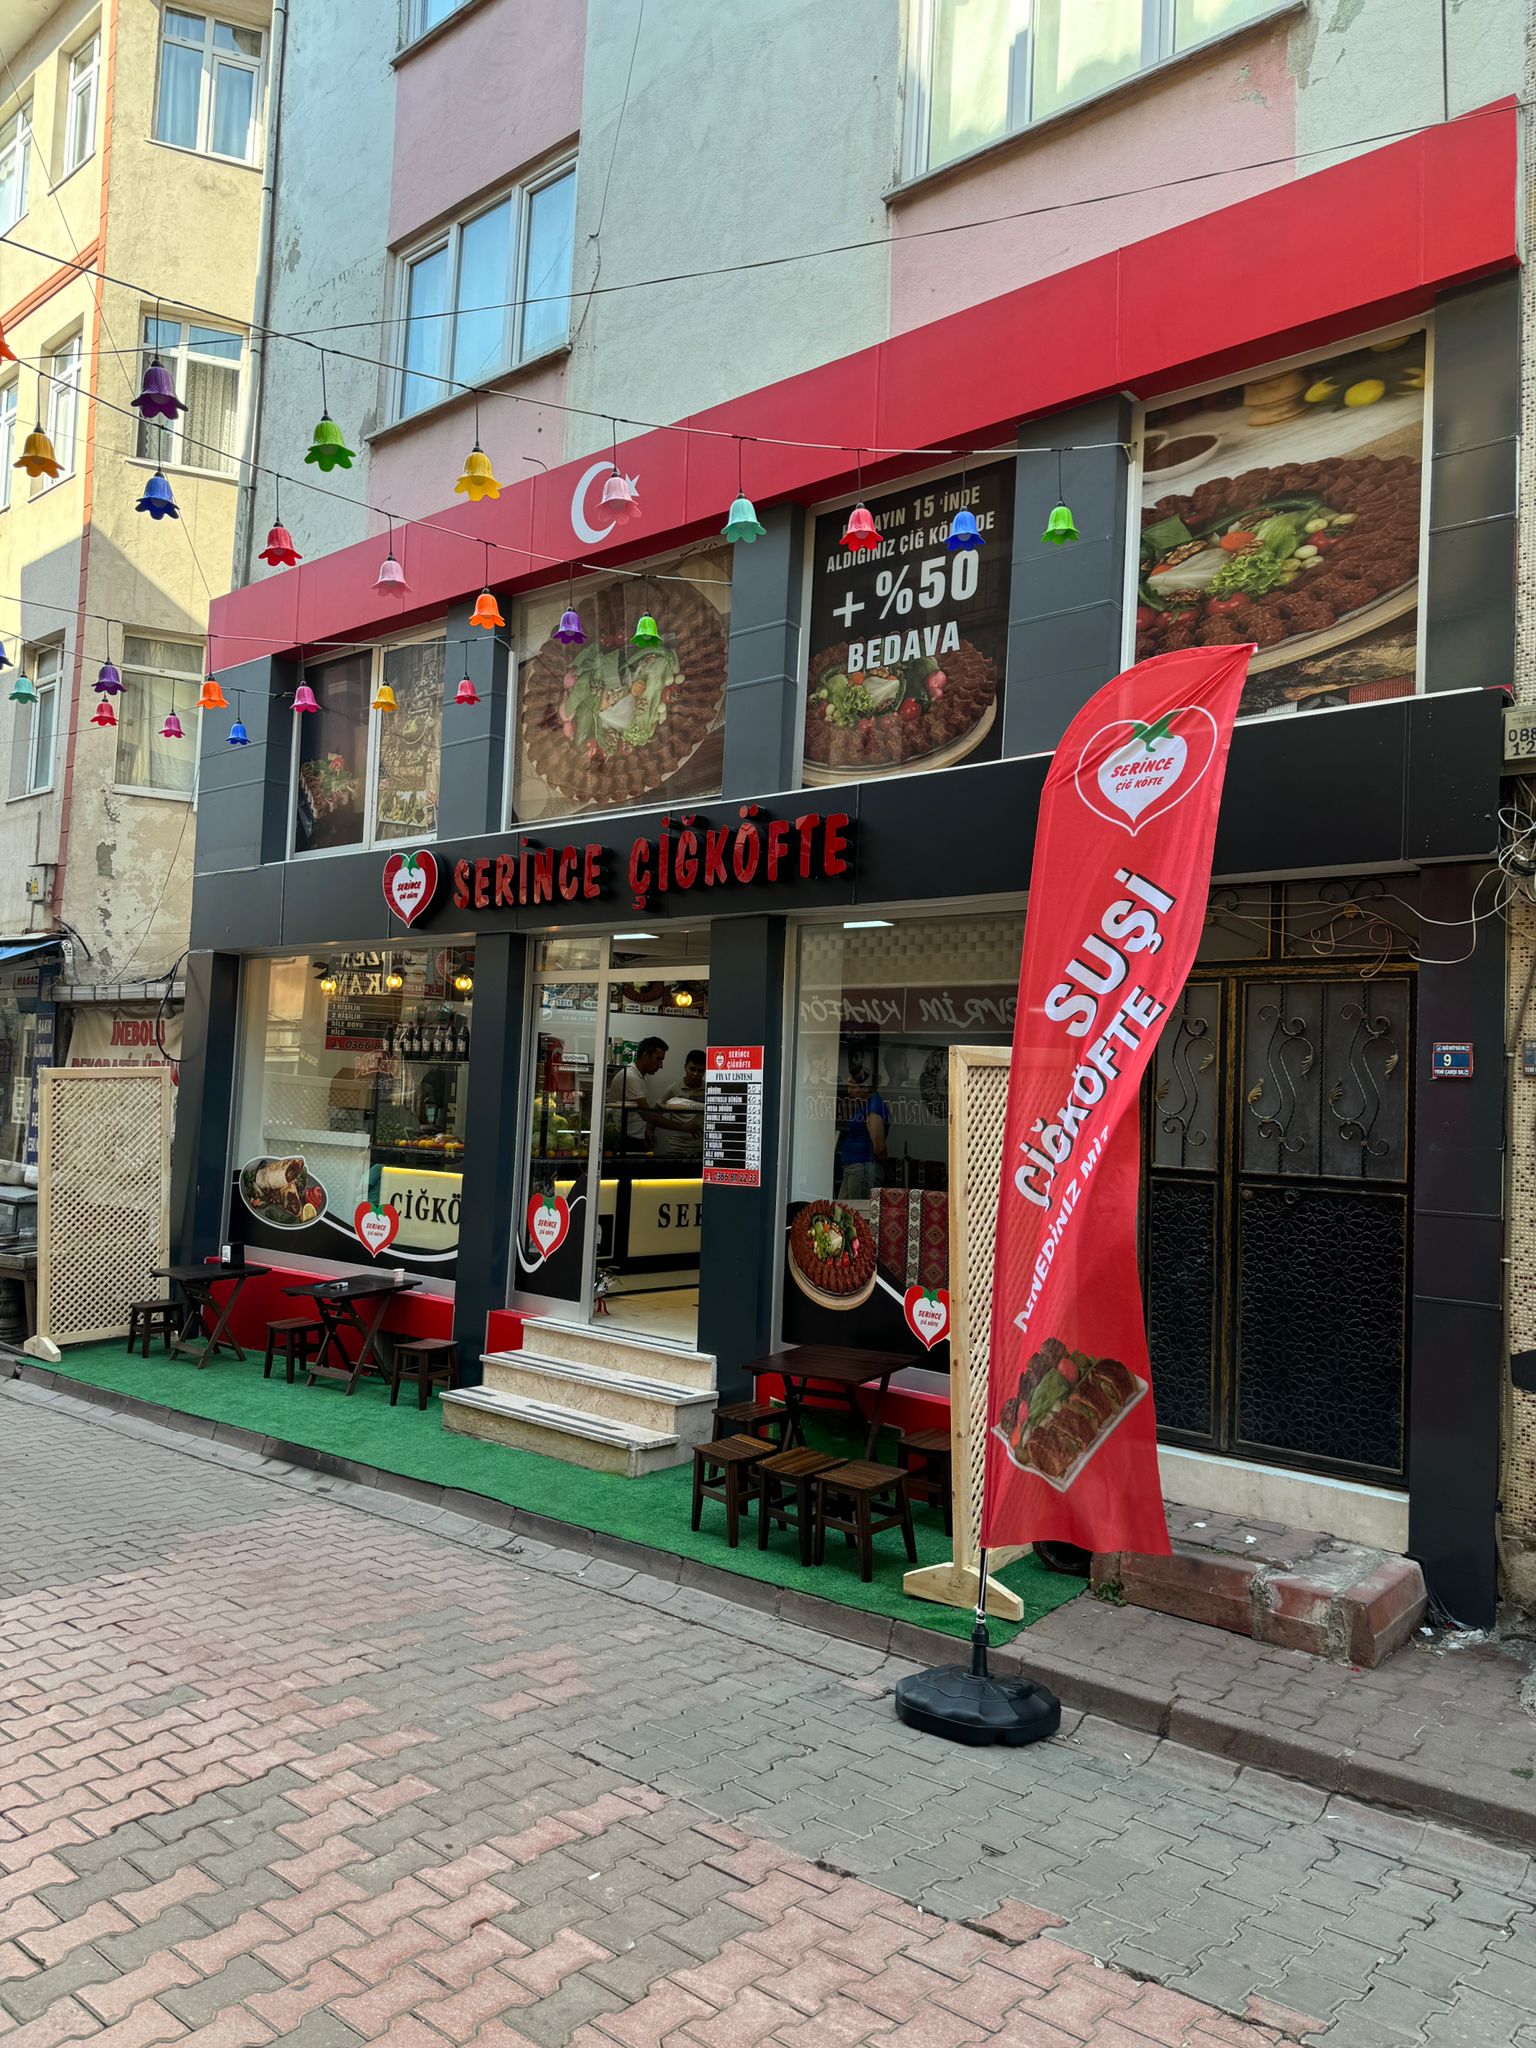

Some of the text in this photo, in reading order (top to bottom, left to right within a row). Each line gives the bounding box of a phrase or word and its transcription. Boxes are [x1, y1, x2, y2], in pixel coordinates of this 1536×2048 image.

[913, 495, 935, 521] 15
[900, 528, 925, 554] ÇİĞ
[876, 549, 979, 620] %50
[848, 621, 960, 674] BEDAVA
[1110, 757, 1174, 779] SERİNCE
[1115, 775, 1164, 793] ÇİĞ KÖFTE
[452, 803, 850, 911] SERİNCE ÇİĞKÖFTE
[1044, 867, 1177, 1038] SUŞİ
[110, 1016, 165, 1046] İNEBOLU
[345, 1040, 371, 1050] 0366
[728, 1049, 750, 1058] SERİNCE
[726, 1058, 751, 1069] ÇİĞKÖFTE
[1443, 1053, 1452, 1067] 9
[1014, 985, 1167, 1211] ÇİĞKÖFTE
[714, 1172, 728, 1181] 0366
[740, 1173, 748, 1182] 22
[749, 1174, 757, 1183] 33
